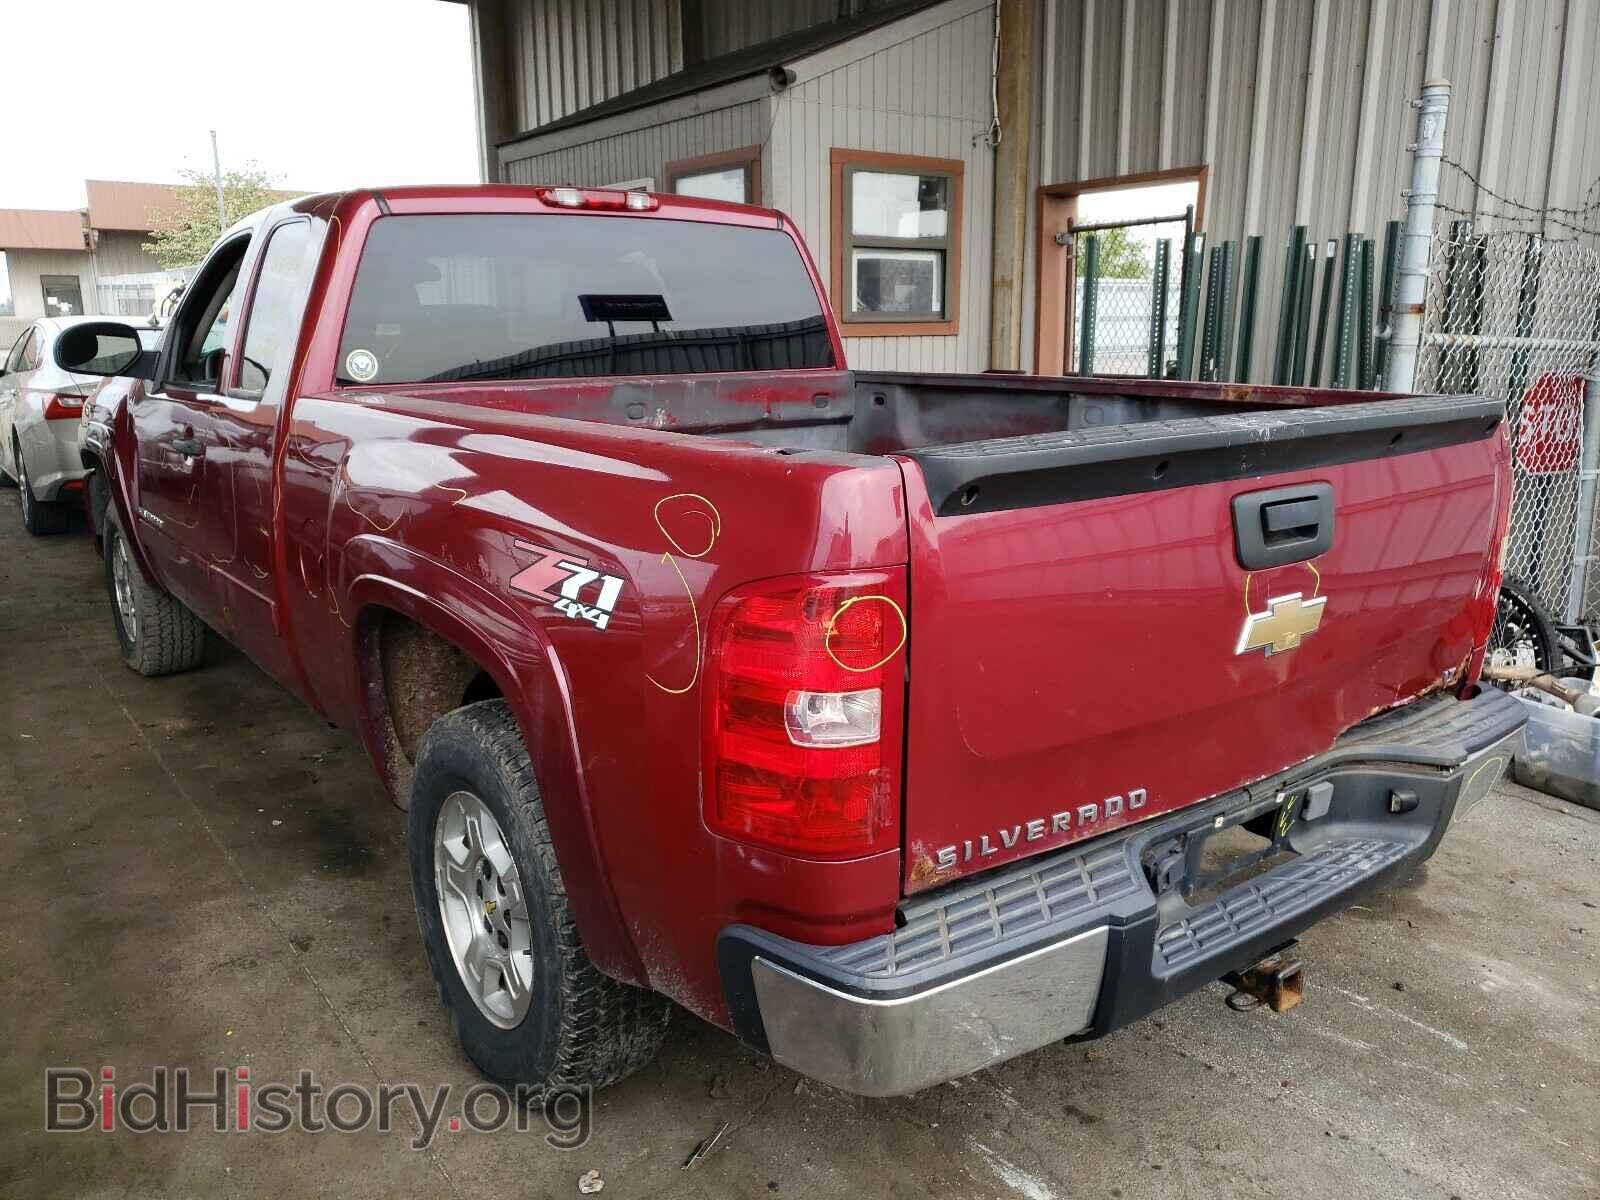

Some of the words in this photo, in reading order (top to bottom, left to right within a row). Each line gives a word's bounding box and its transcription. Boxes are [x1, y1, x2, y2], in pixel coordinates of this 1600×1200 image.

[1518, 403, 1580, 443] STO
[510, 538, 625, 614] Z71
[552, 597, 610, 631] 4x4
[935, 787, 1148, 872] SILVERADO
